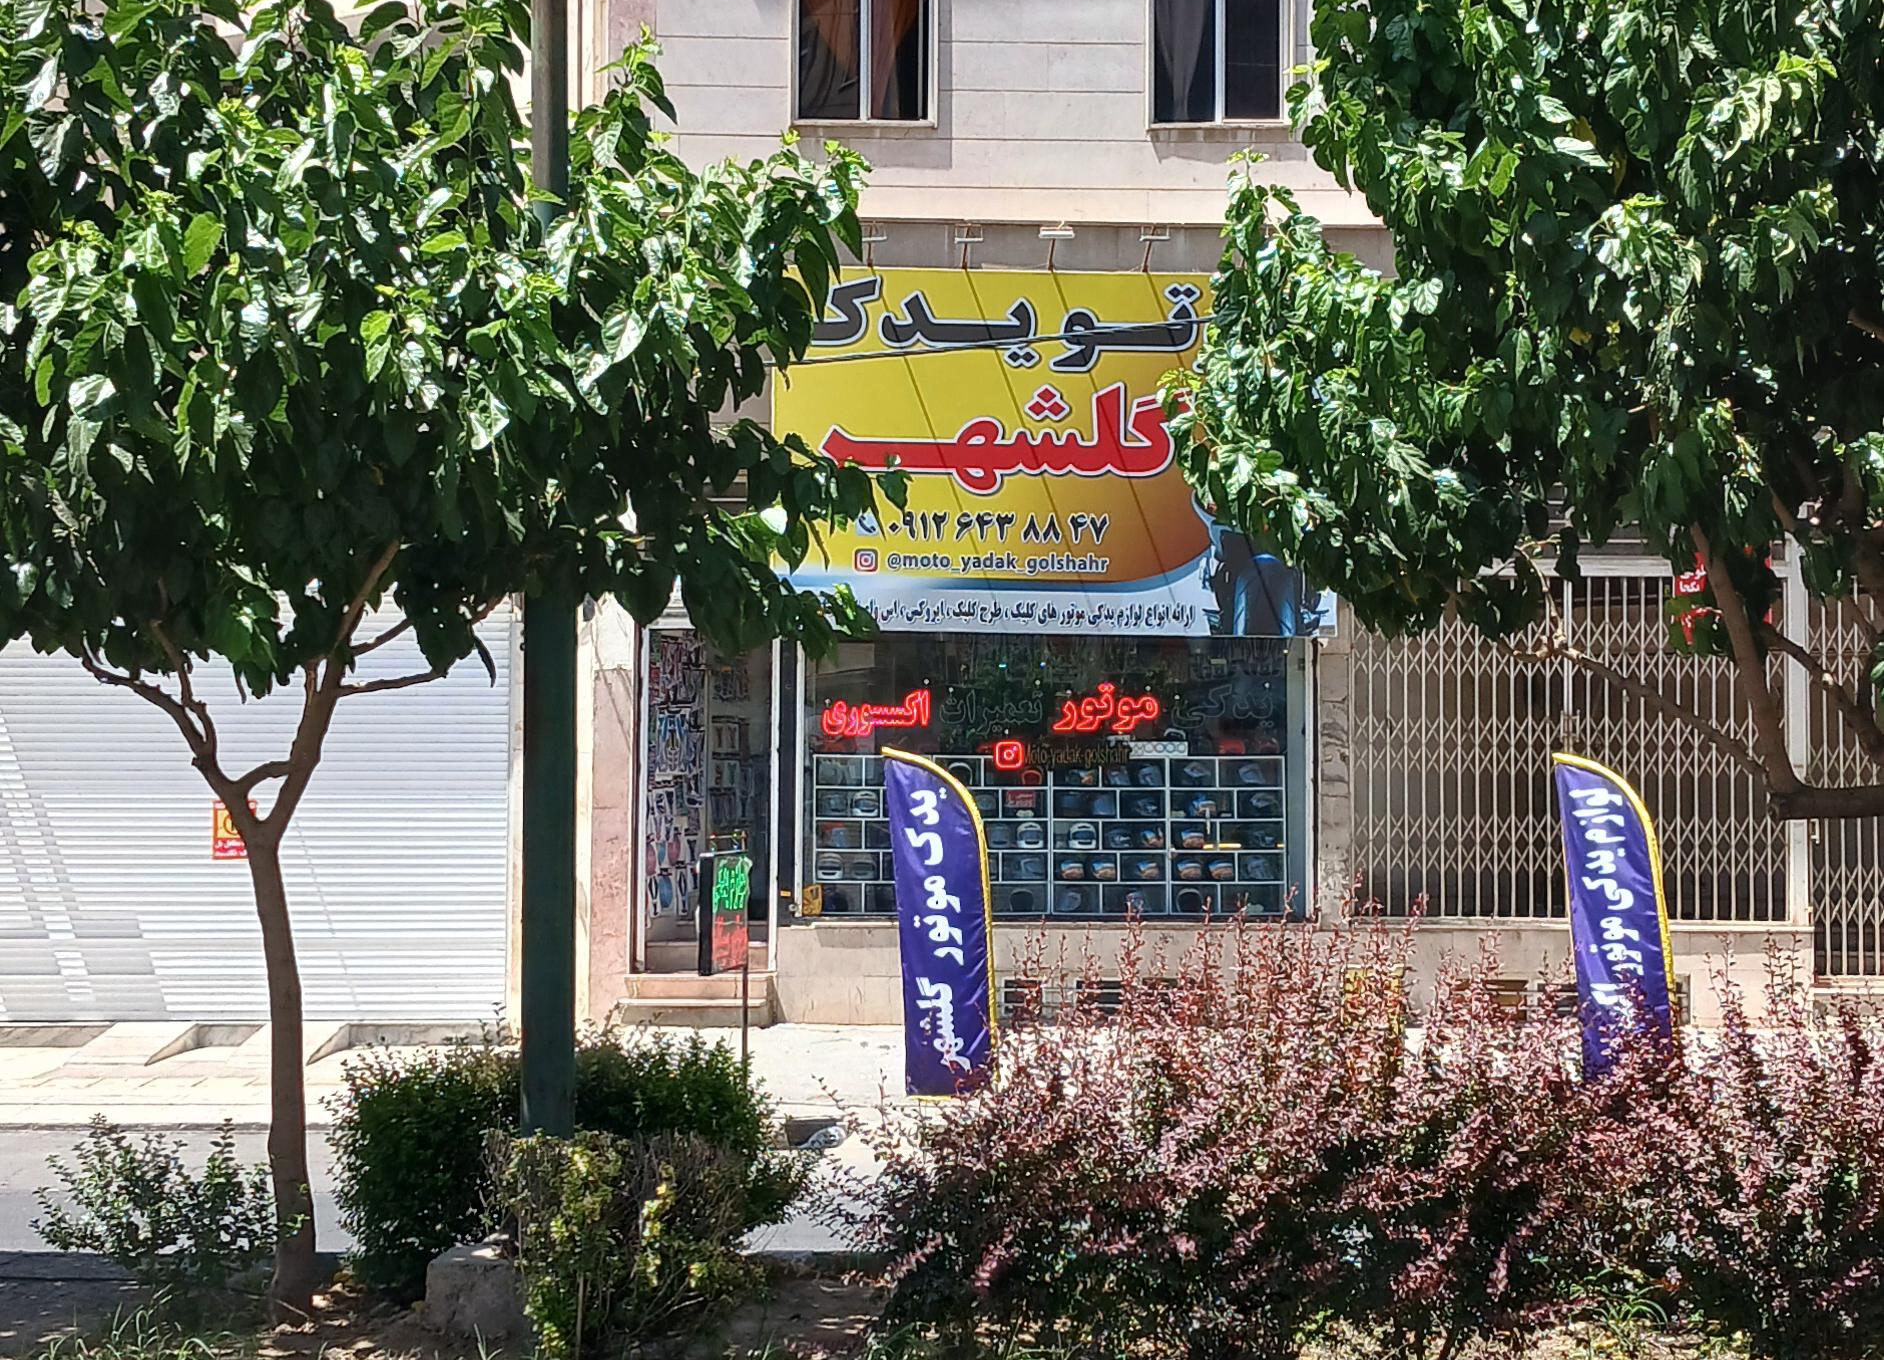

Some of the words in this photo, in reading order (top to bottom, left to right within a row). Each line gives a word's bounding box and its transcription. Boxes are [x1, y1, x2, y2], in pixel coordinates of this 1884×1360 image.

[819, 381, 1193, 495] گلشهر
[888, 510, 948, 542] ۰۹۱۲
[954, 510, 1016, 542] ۶۴۳
[1021, 513, 1063, 544] ۸۸
[1069, 512, 1110, 544] ۴۷
[887, 551, 1109, 575] @moto_yadak_golshahr
[1037, 601, 1058, 625] های
[1059, 602, 1086, 626] موتور
[939, 688, 1045, 737] تعمیرات
[1052, 682, 1160, 732] موتور
[1171, 684, 1274, 728] یدکی
[903, 787, 948, 866] یدک
[1569, 787, 1626, 844] لوازم
[1581, 847, 1635, 911] یدکی
[914, 875, 965, 966] موتور
[1589, 916, 1645, 976] موتور
[915, 976, 973, 1075] گلشهر
